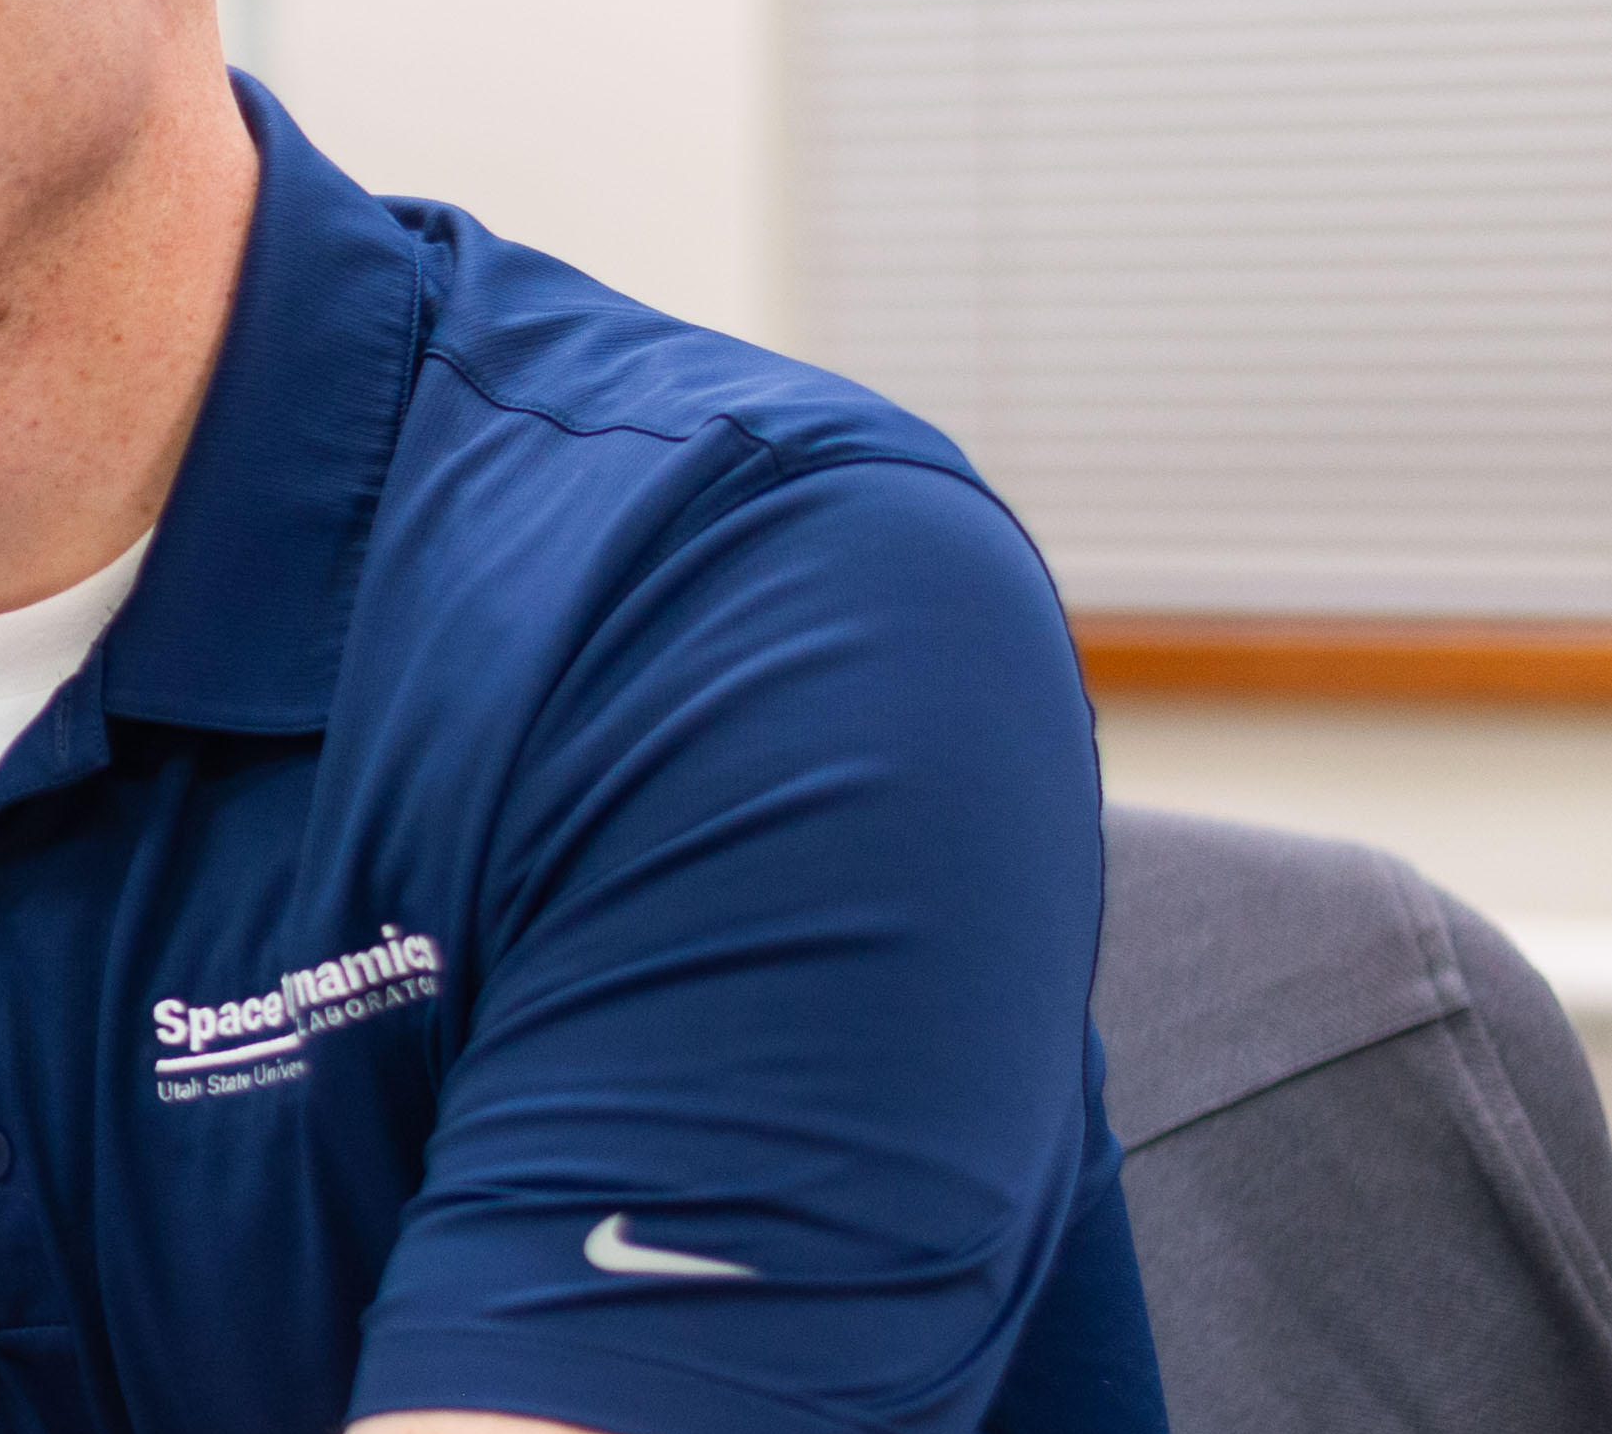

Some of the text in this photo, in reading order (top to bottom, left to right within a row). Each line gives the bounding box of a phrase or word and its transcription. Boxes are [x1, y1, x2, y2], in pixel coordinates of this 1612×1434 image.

[153, 990, 284, 1053] Space
[157, 1078, 203, 1102] Utah
[207, 1071, 251, 1095] State
